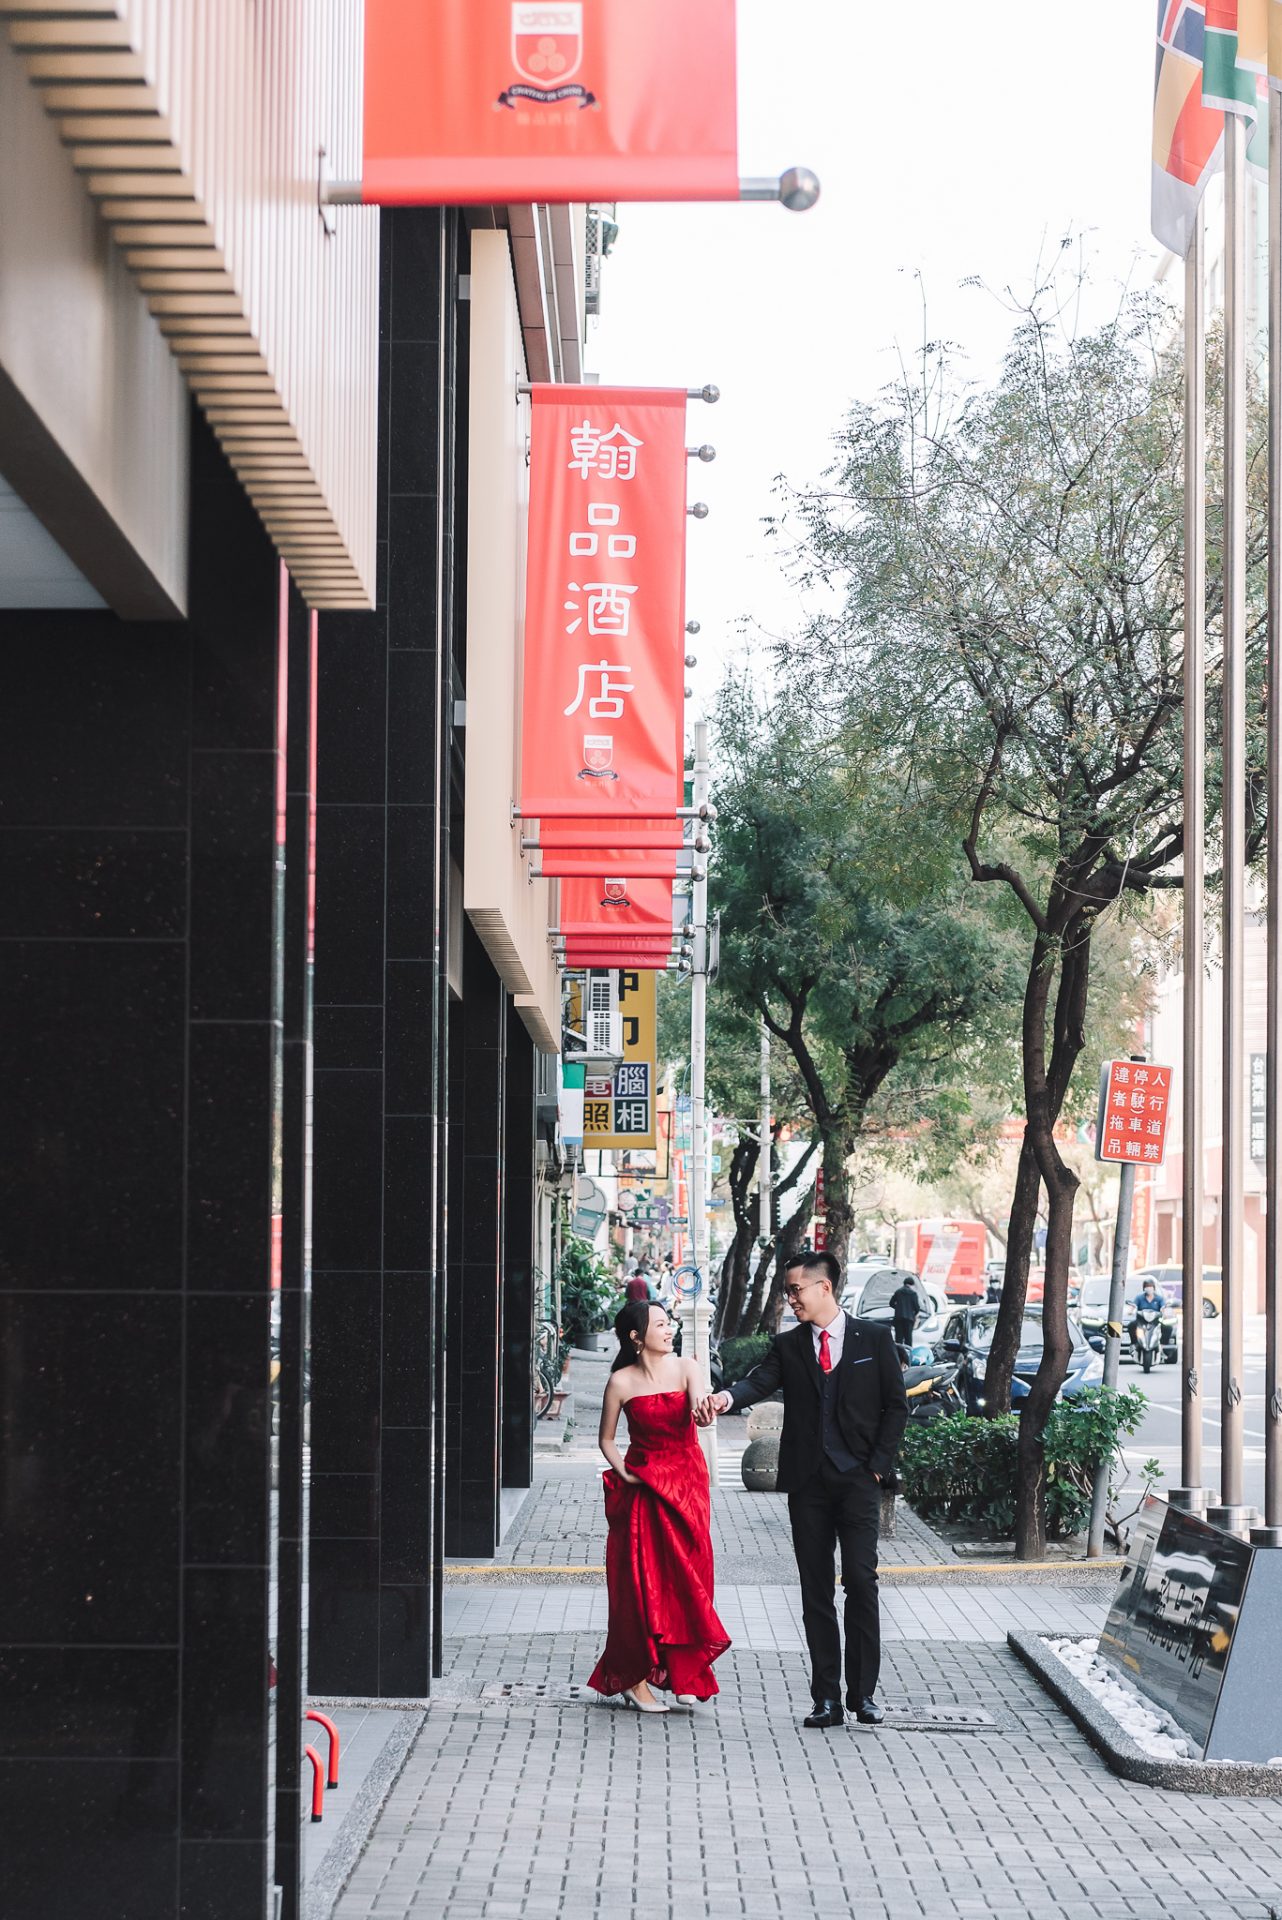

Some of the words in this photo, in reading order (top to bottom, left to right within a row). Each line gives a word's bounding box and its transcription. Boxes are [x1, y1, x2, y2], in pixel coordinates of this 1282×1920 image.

[564, 420, 644, 719] 翰品酒店
[1107, 1066, 1130, 1154] 違者拖吊
[1125, 1069, 1149, 1157] 停(駛)車輛
[1144, 1072, 1166, 1159] 人行道禁
[1252, 1056, 1265, 1158] 台灣第一選擇
